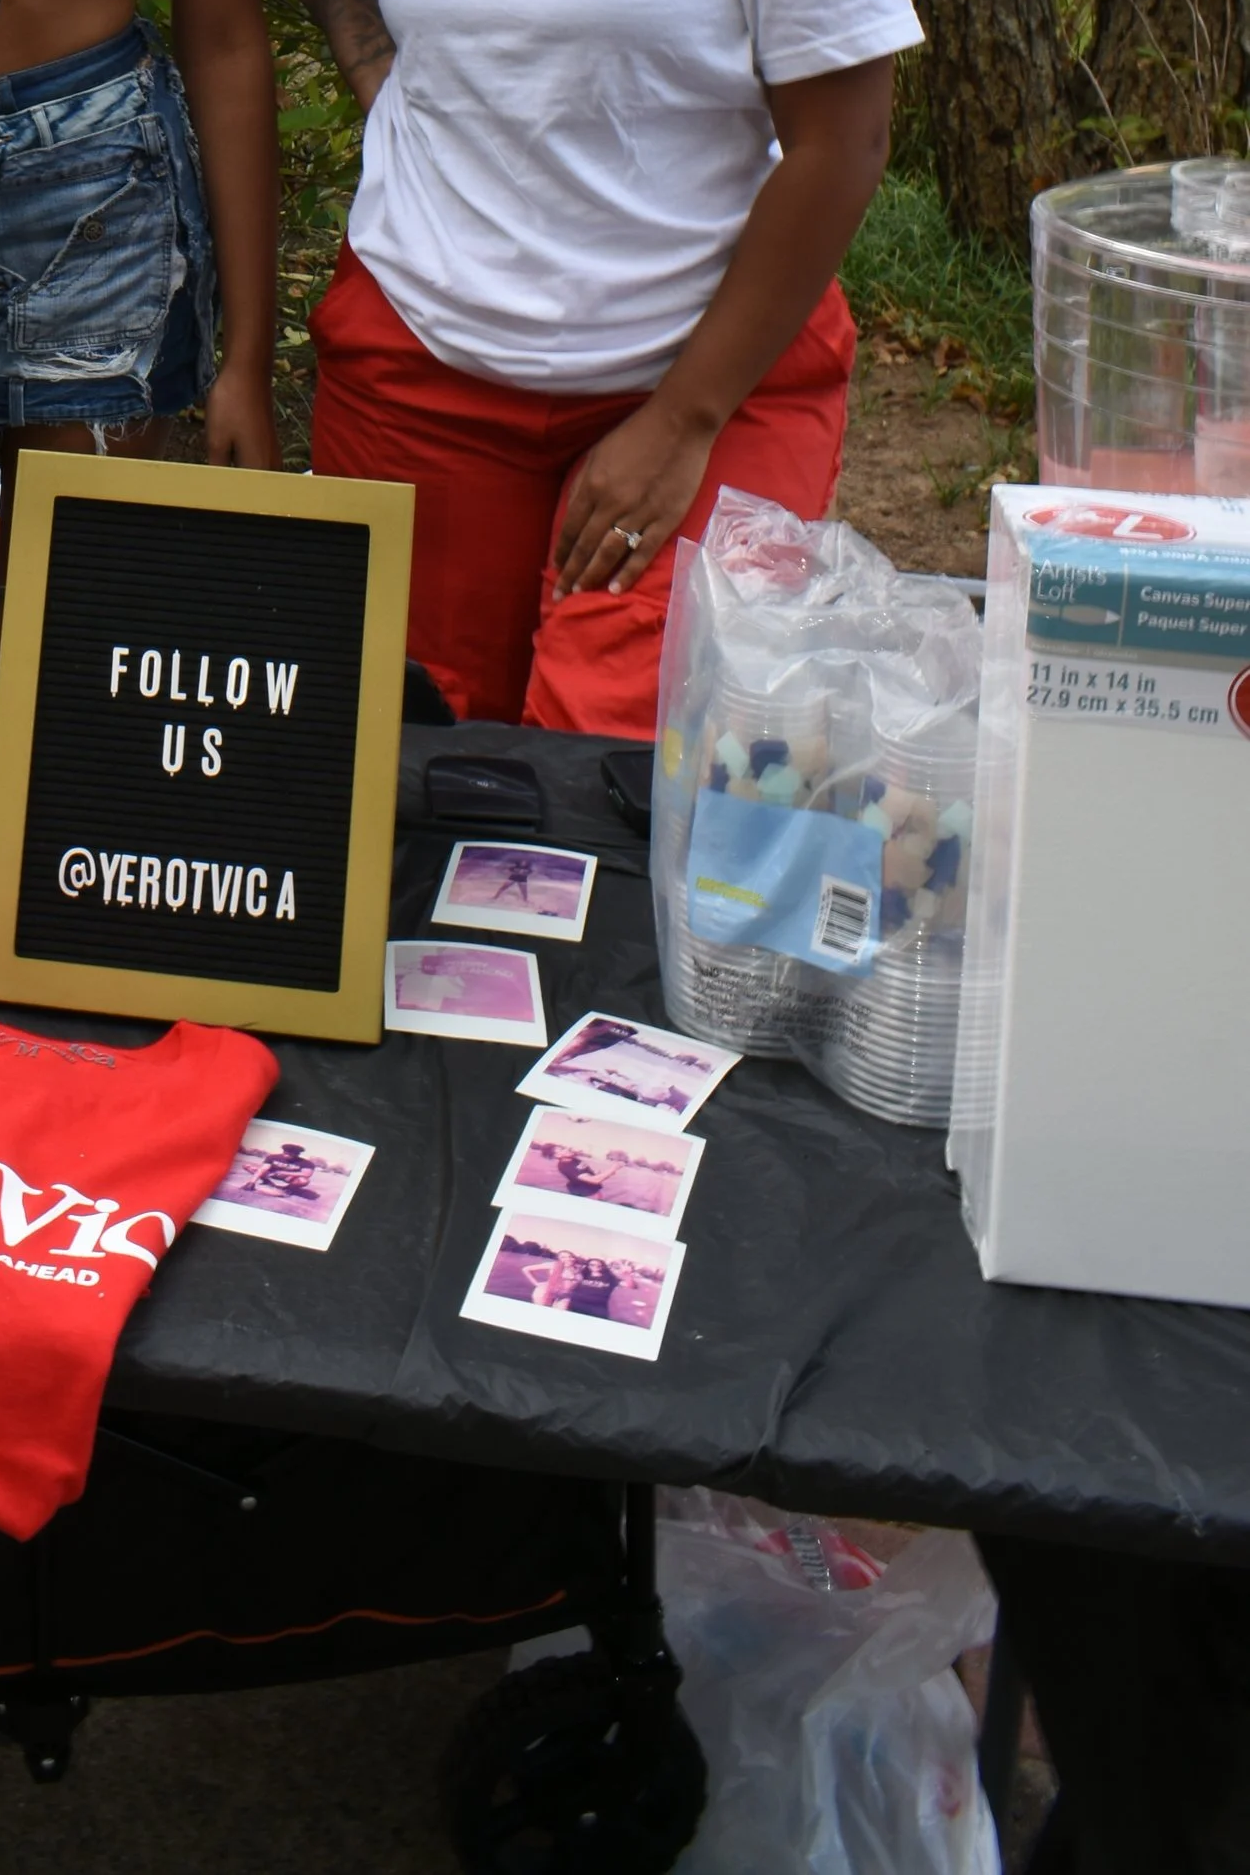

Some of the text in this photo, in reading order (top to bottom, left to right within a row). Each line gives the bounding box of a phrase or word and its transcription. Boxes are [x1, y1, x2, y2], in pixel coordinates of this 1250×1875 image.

[1037, 559, 1107, 587] Artist's
[1036, 579, 1076, 604] Loft
[1140, 585, 1250, 614] Canvas Super
[1137, 609, 1247, 637] Paquet Super
[109, 646, 299, 715] FOLLOW
[1031, 662, 1156, 695] 11 in x 14 in
[1026, 685, 1220, 725] 27.9 cm x 35.5 cm
[161, 724, 223, 777] US
[58, 846, 296, 920] @YEROTVICA
